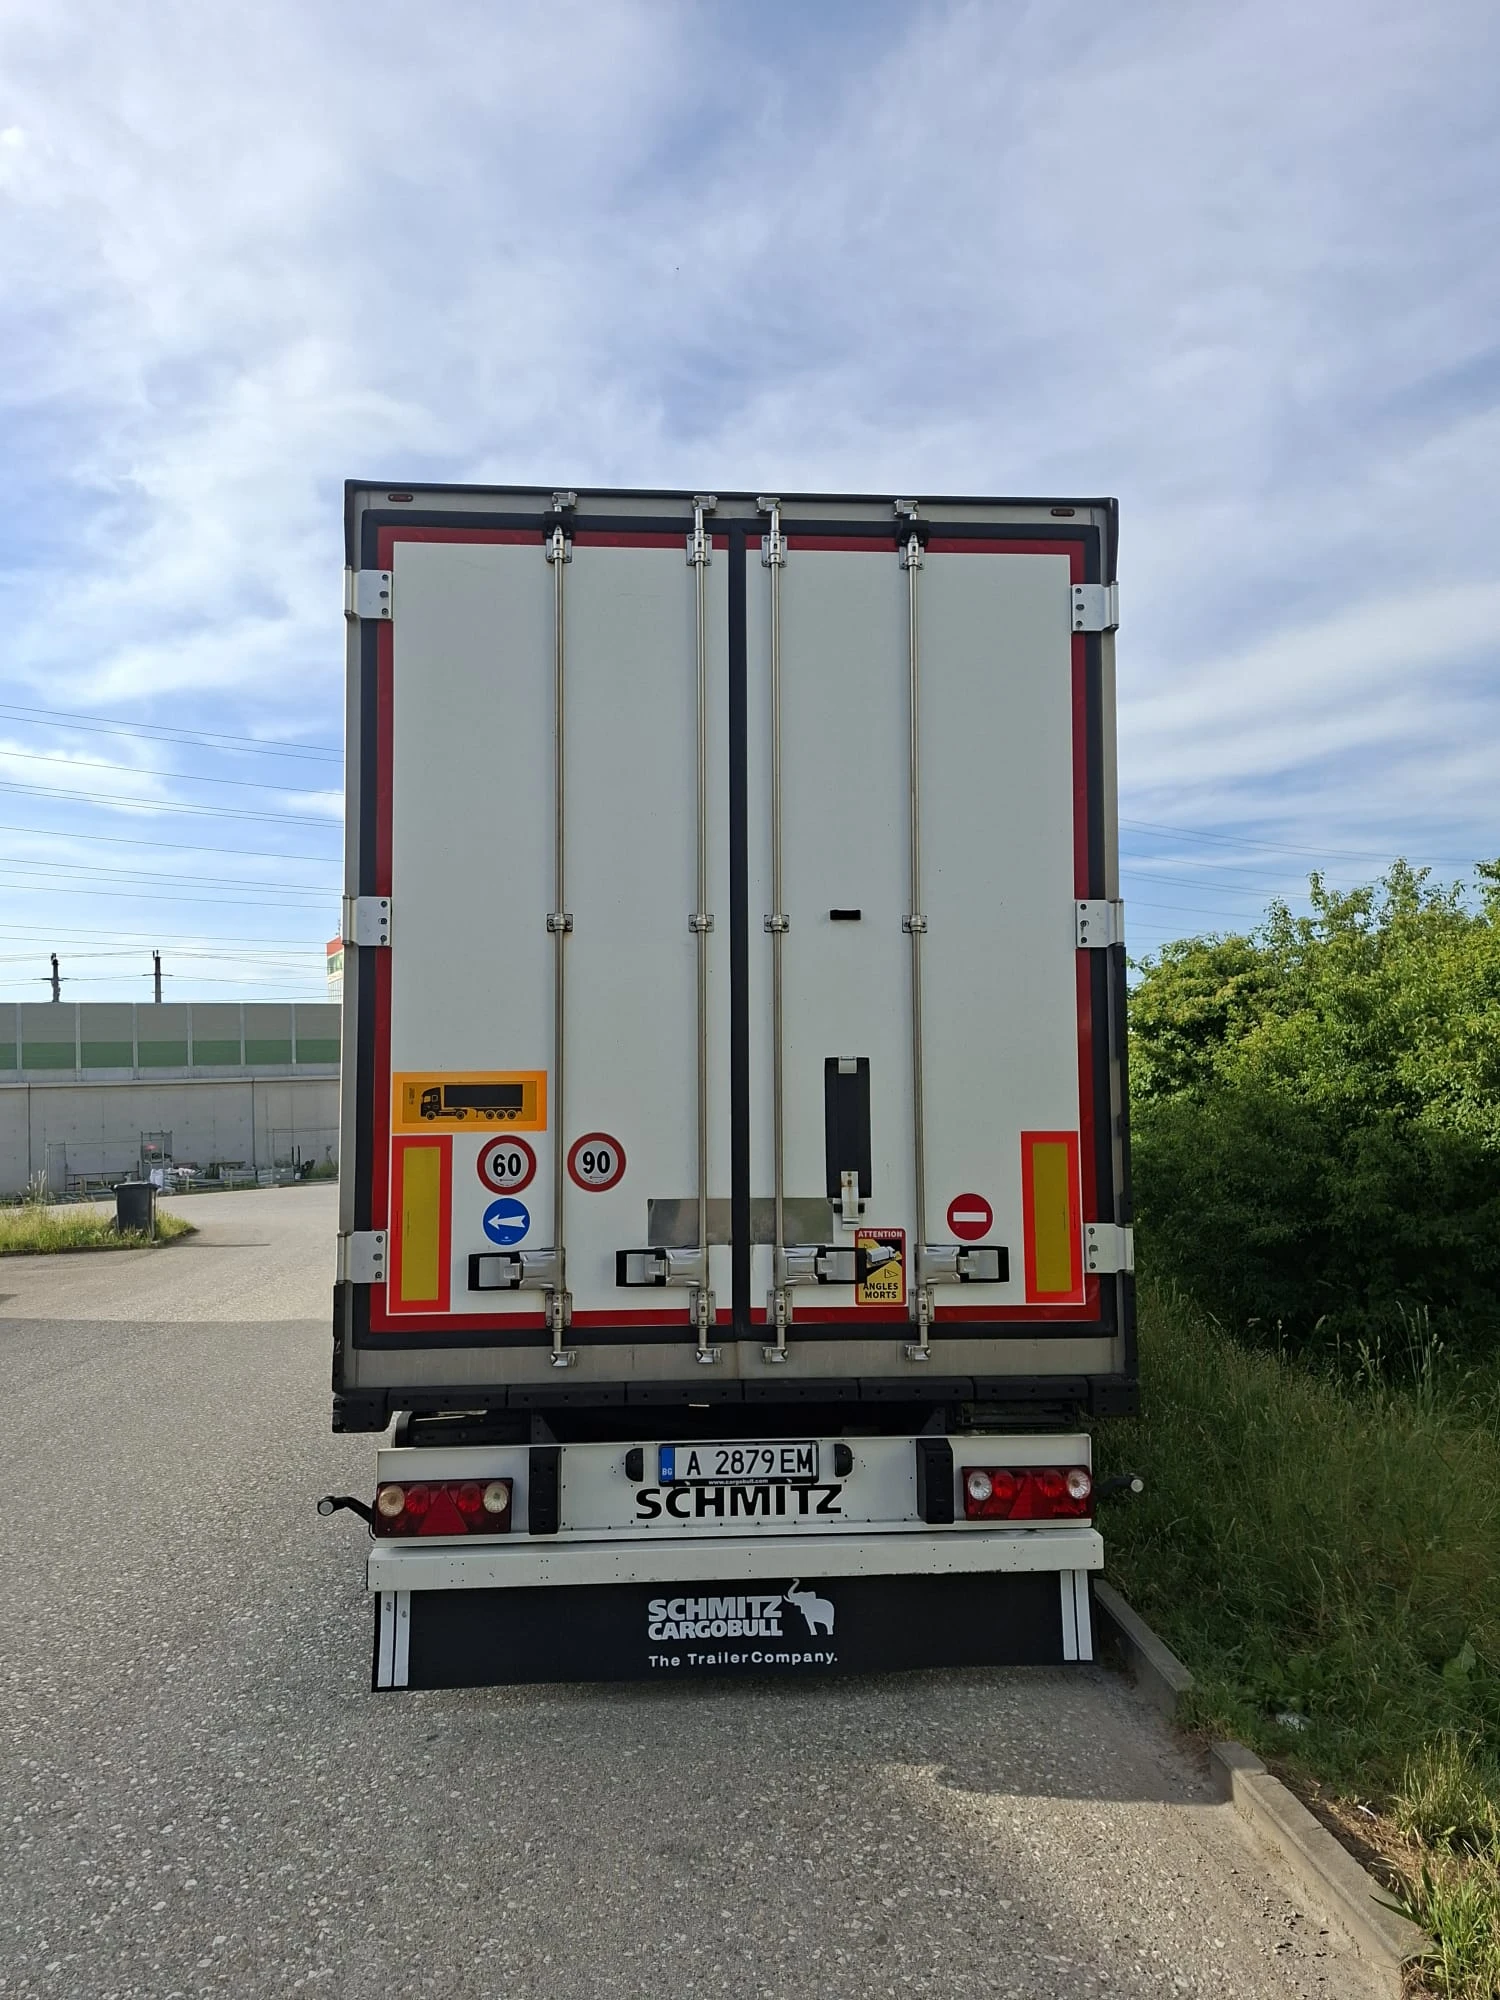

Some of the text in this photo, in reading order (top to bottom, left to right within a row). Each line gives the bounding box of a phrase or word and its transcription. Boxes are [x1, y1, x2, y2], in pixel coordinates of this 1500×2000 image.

[492, 1153, 522, 1178] 60
[582, 1150, 611, 1175] 90
[858, 1230, 903, 1238] ATTENTION
[863, 1282, 899, 1290] ANGLES
[864, 1291, 897, 1299] MORTS
[662, 1467, 673, 1476] BG
[686, 1451, 701, 1476] A
[636, 1484, 842, 1519] SCHMITZ
[648, 1595, 782, 1622] SCHMITZ
[648, 1619, 783, 1640] CARGOBULL
[648, 1654, 681, 1668] The
